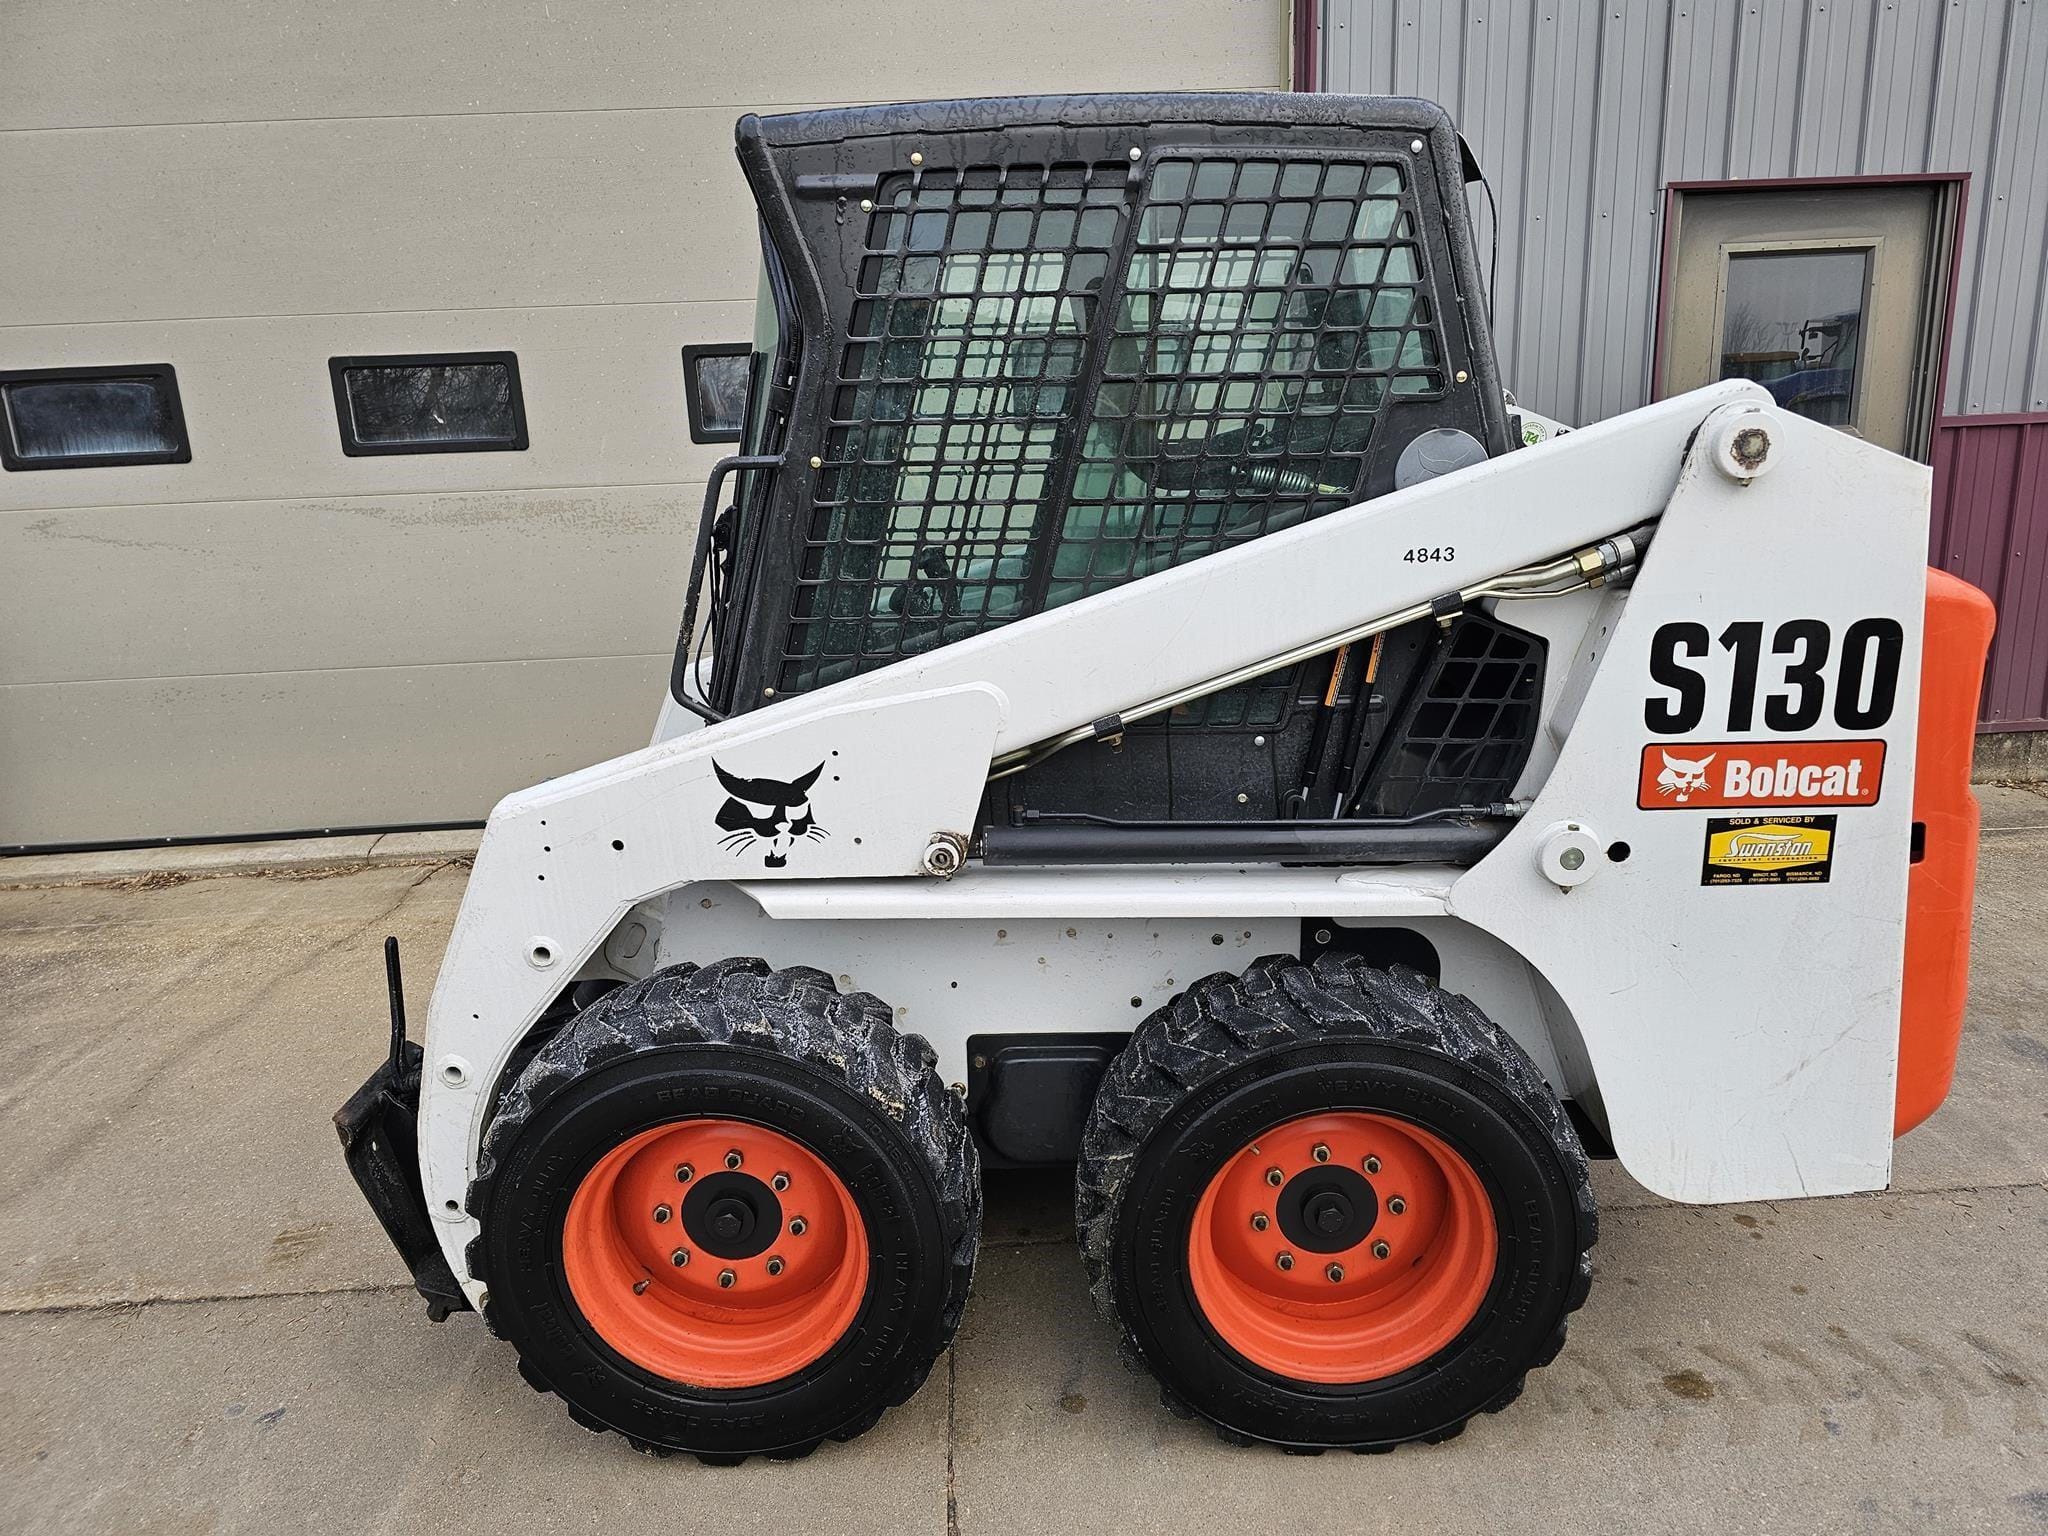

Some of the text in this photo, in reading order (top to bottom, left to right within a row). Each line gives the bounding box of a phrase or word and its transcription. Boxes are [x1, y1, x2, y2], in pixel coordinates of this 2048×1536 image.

[1403, 546, 1455, 564] 4843
[1644, 617, 1904, 735] S130
[1723, 759, 1862, 798] Bobcat
[1725, 832, 1813, 858] Swanston
